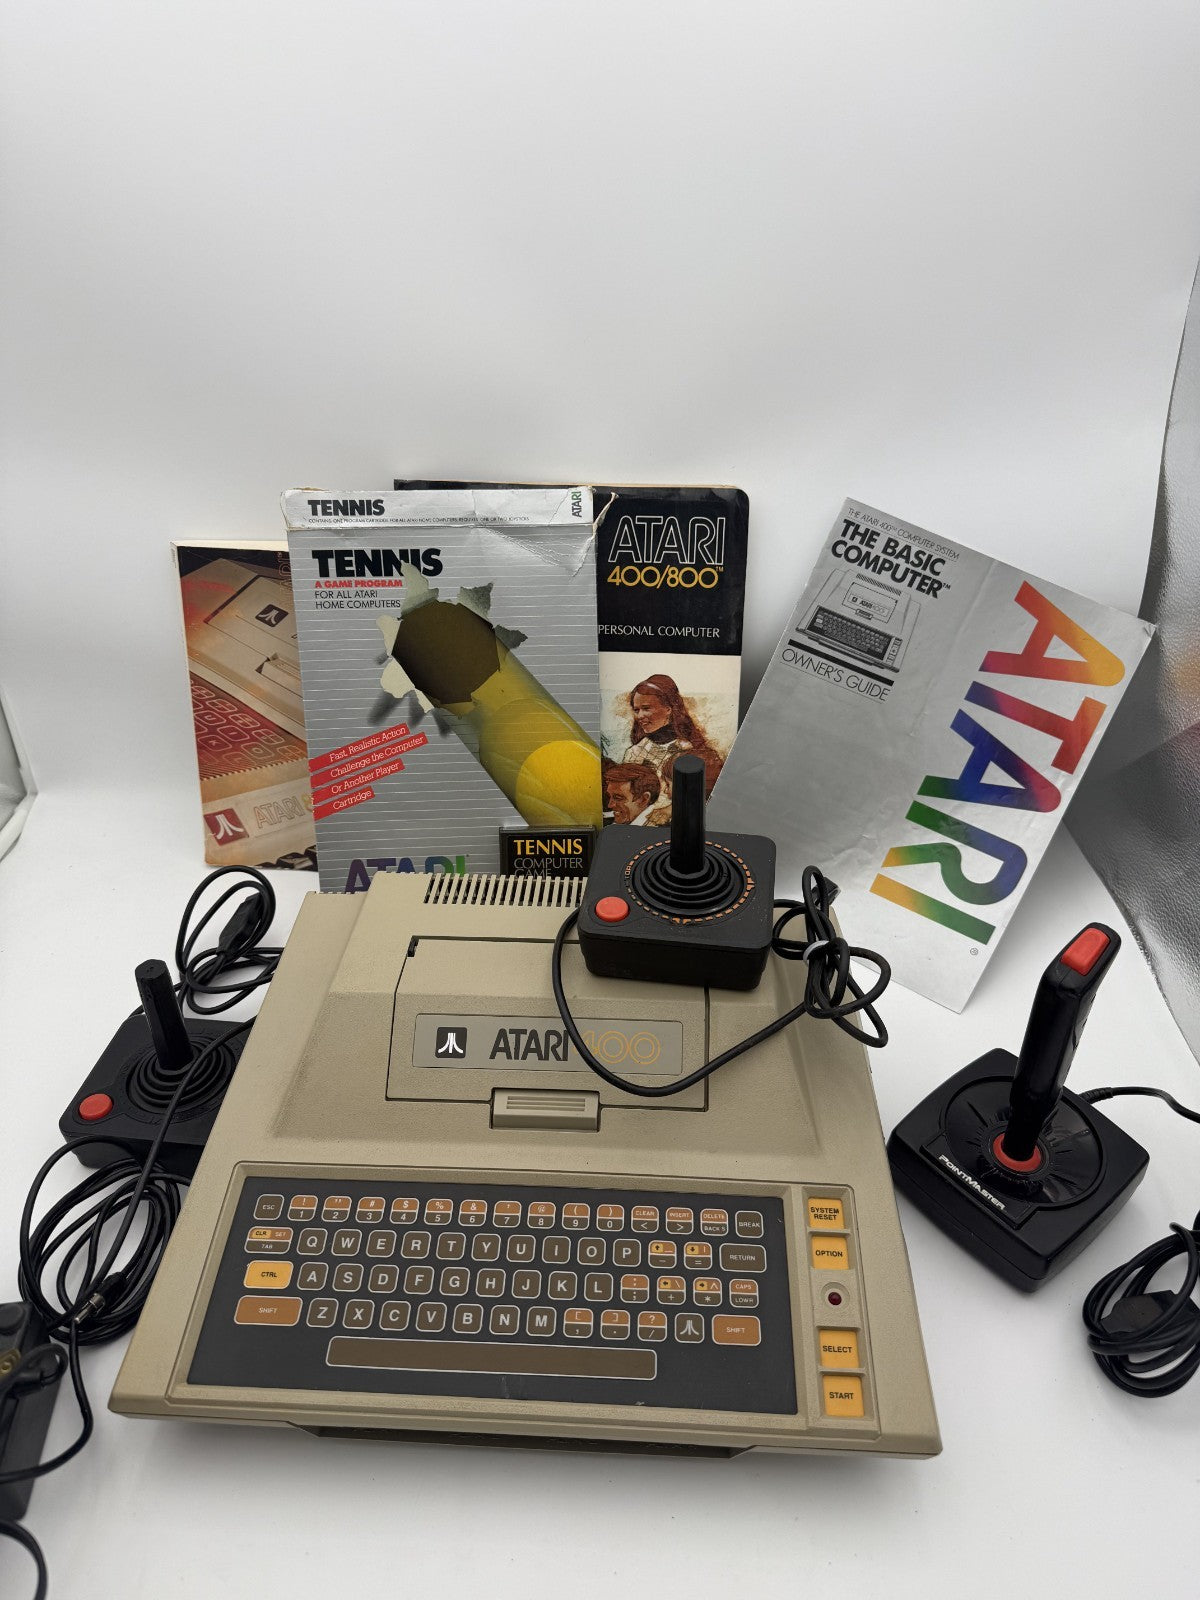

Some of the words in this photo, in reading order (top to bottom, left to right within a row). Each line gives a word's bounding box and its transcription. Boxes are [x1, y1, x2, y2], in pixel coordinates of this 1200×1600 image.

[307, 499, 385, 516] TENNIS
[571, 490, 582, 518] ATARI
[608, 515, 726, 566] ATARI
[898, 527, 935, 549] COMPUTER
[935, 542, 960, 560] SYSTEM
[841, 518, 880, 550] THE
[881, 537, 946, 577] BASIC
[312, 548, 443, 577] TENNIS
[315, 580, 322, 588] A
[324, 580, 352, 588] GAME
[354, 579, 403, 588] PROGRAM
[315, 591, 334, 599] FOR
[336, 590, 352, 599] ALL
[354, 590, 378, 598] ATARI
[315, 600, 344, 609] HOME
[346, 600, 401, 609] COMPUTERS
[598, 624, 654, 636] PERSONAL
[657, 625, 720, 638] COMPUTER
[782, 648, 845, 683] OWNER'S
[846, 675, 891, 702] GUIDE
[348, 738, 381, 755] Realistic
[382, 727, 406, 742] Action
[330, 757, 370, 778] Challenge
[371, 752, 384, 762] the
[384, 736, 424, 757] Computer
[870, 580, 1126, 945] ATARI
[331, 784, 342, 794] Or
[344, 772, 375, 790] Another
[375, 762, 400, 777] Player
[333, 790, 372, 810] Cartridge
[254, 796, 305, 829] ATARI
[513, 838, 583, 856] TENNIS
[513, 857, 583, 869] COMPUTER
[514, 868, 552, 878] GAME
[489, 1028, 568, 1062] ATARI
[938, 1154, 1006, 1211] POINTMASTER
[436, 1201, 444, 1210] %
[470, 1203, 477, 1211] &
[810, 1206, 839, 1214] SYSTEM
[435, 1214, 441, 1222] 5
[538, 1218, 544, 1226] 8
[573, 1219, 578, 1227] 9
[814, 1213, 837, 1221] RESET
[738, 1221, 761, 1229] BREAK
[306, 1236, 318, 1248] Q
[341, 1237, 355, 1248] W
[377, 1238, 386, 1250] E
[411, 1239, 421, 1251] R
[447, 1240, 456, 1252] T
[482, 1242, 491, 1253] Y
[516, 1243, 526, 1254] U
[586, 1246, 597, 1257] O
[622, 1247, 632, 1259] P
[815, 1249, 843, 1258] OPTION
[306, 1271, 318, 1283] A
[343, 1271, 353, 1284] S
[378, 1273, 389, 1285] D
[414, 1274, 424, 1286] F
[449, 1275, 460, 1288] G
[485, 1277, 496, 1289] H
[521, 1279, 530, 1291] J
[557, 1280, 567, 1292] K
[594, 1281, 602, 1293] L
[317, 1307, 329, 1319] Z
[353, 1308, 364, 1321] X
[389, 1309, 400, 1322] C
[426, 1311, 437, 1323] V
[462, 1312, 473, 1324] B
[499, 1313, 510, 1326] N
[535, 1315, 547, 1327] M
[822, 1345, 852, 1354] SELECT
[829, 1391, 854, 1401] START
